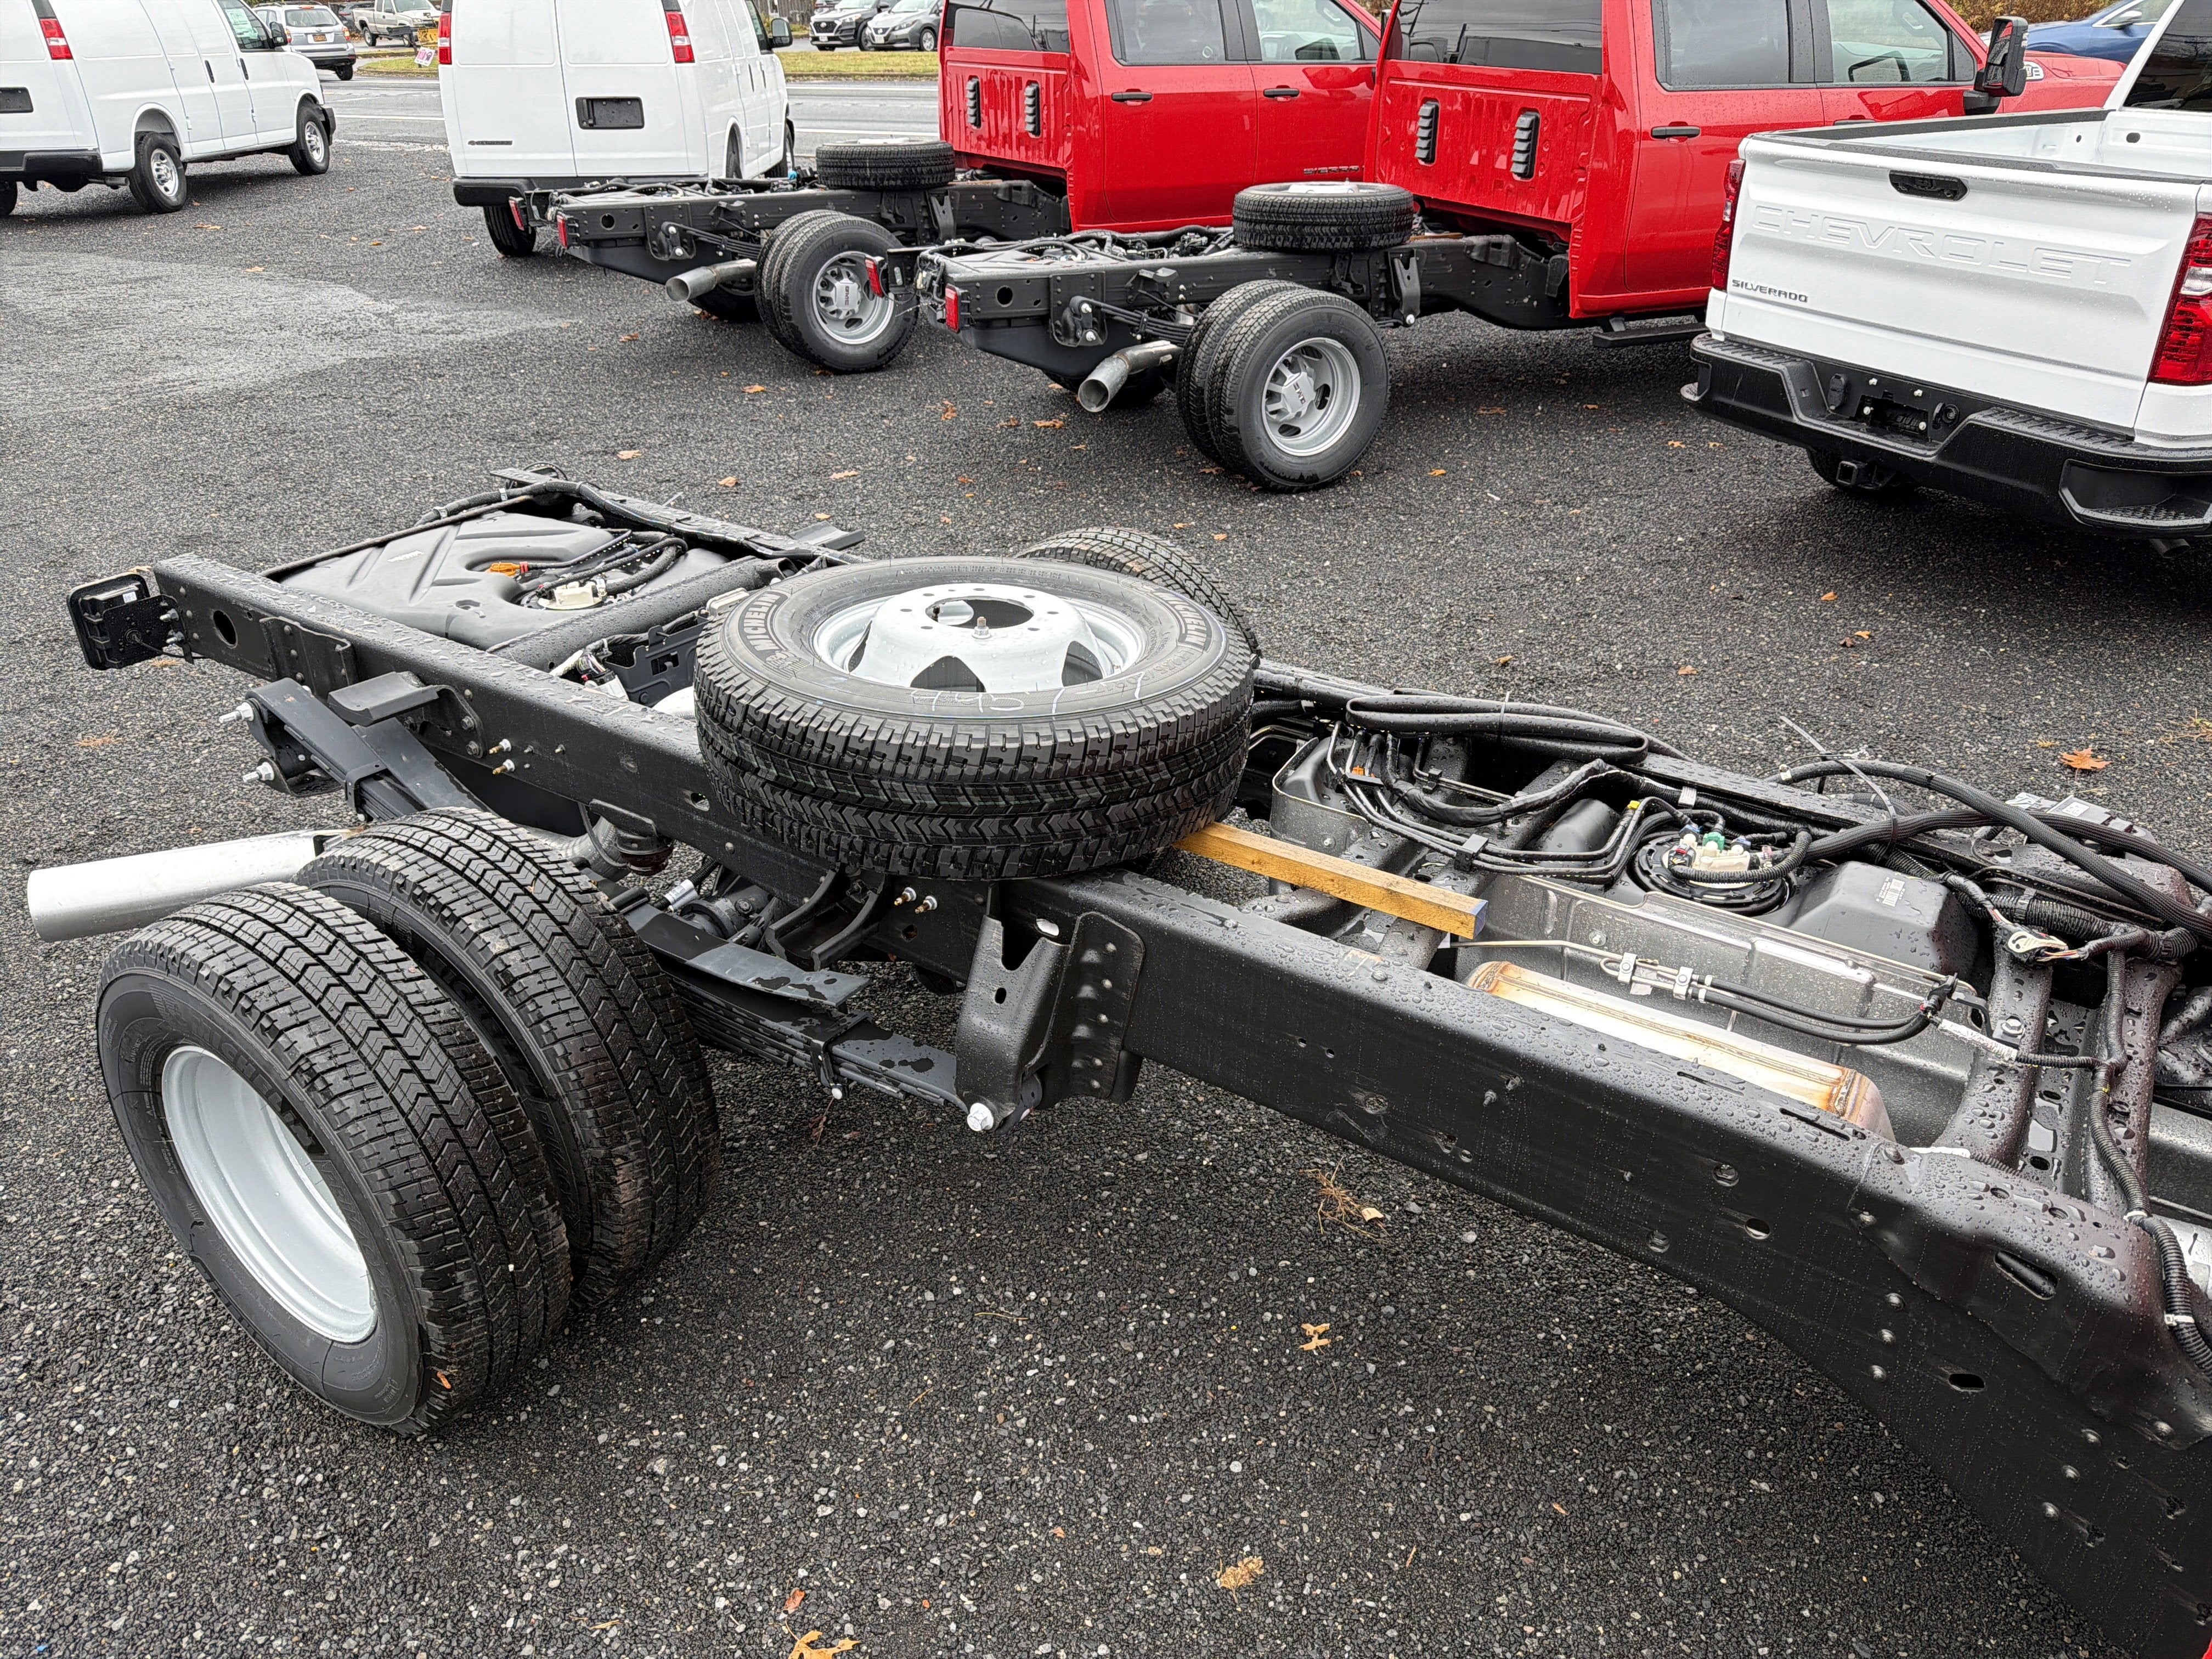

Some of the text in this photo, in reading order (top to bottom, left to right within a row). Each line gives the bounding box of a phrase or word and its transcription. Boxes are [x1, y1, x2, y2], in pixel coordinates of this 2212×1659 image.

[1752, 205, 2131, 284] CHEVROLET
[1731, 279, 1809, 303] SILVERADO
[1293, 381, 1306, 405] GMC
[743, 593, 781, 651] MICHELIN
[1152, 592, 1207, 646] MICHELIN
[191, 1014, 315, 1148] MICHELIN
